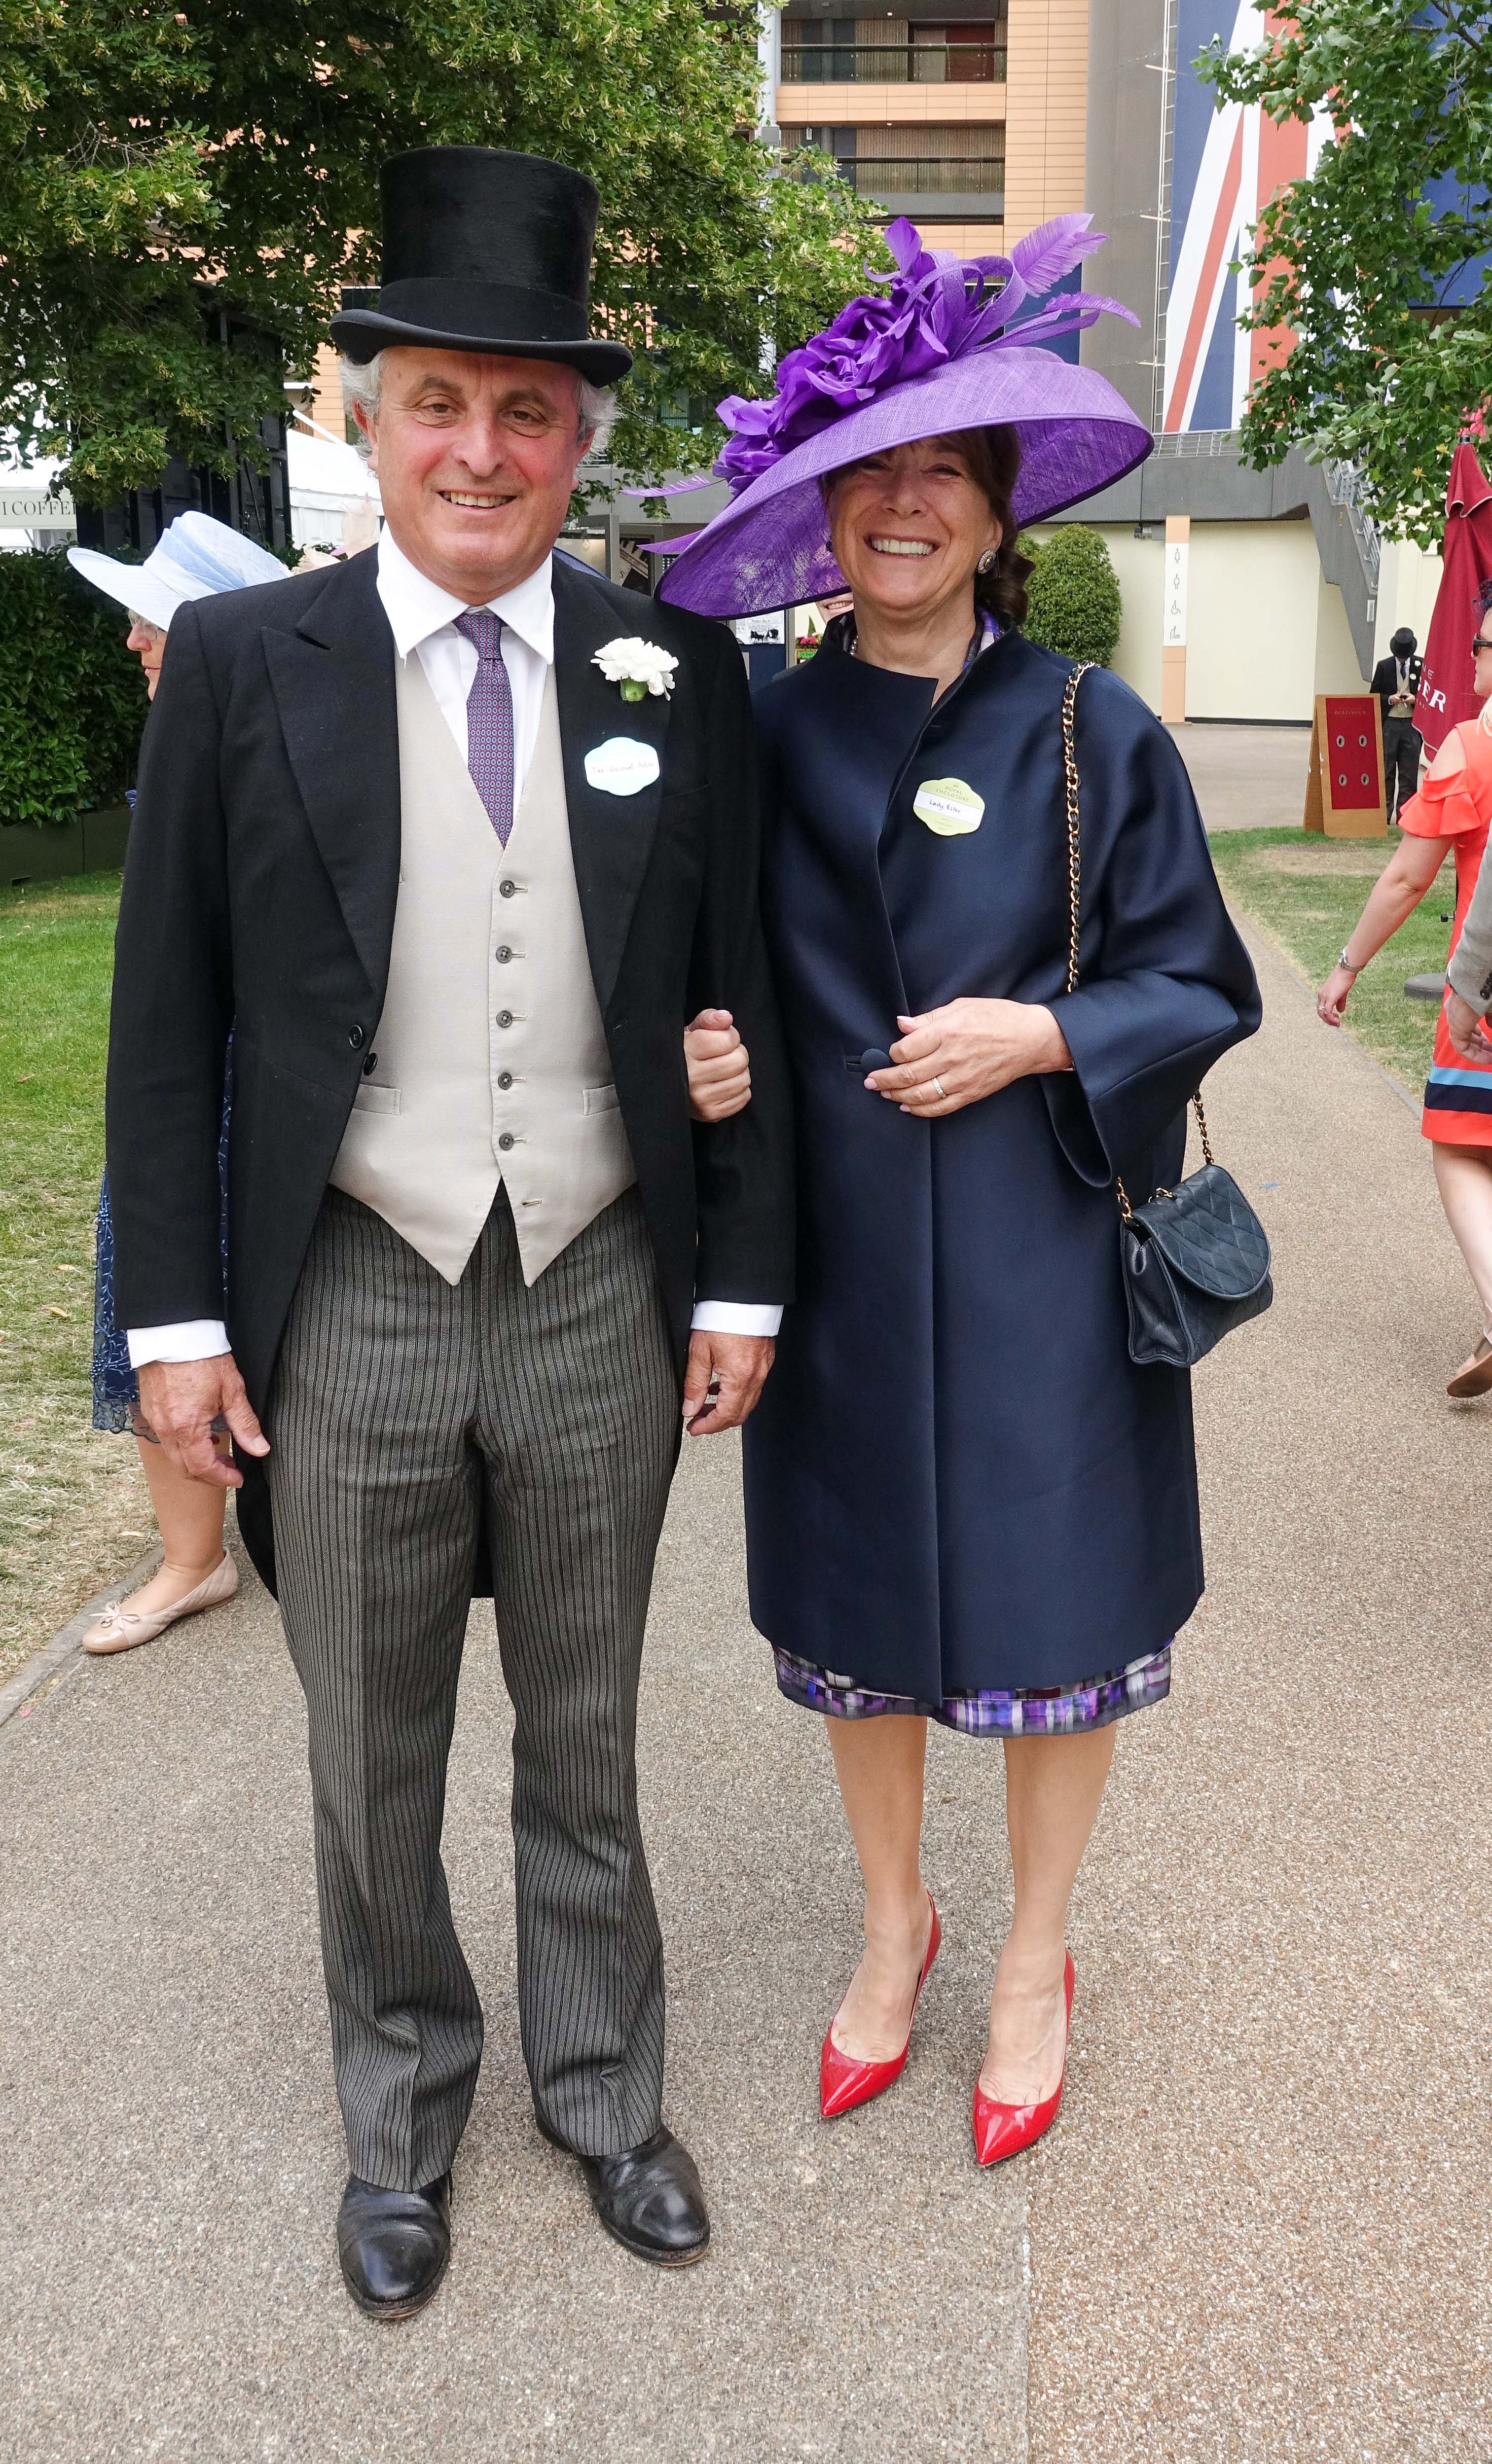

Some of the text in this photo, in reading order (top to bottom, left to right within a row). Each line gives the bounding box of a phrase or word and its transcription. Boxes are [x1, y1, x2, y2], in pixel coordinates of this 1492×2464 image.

[0, 501, 7, 515] I
[935, 788, 970, 802] ENCLOSURE
[945, 785, 962, 795] ROYAL
[929, 799, 944, 811] Lady
